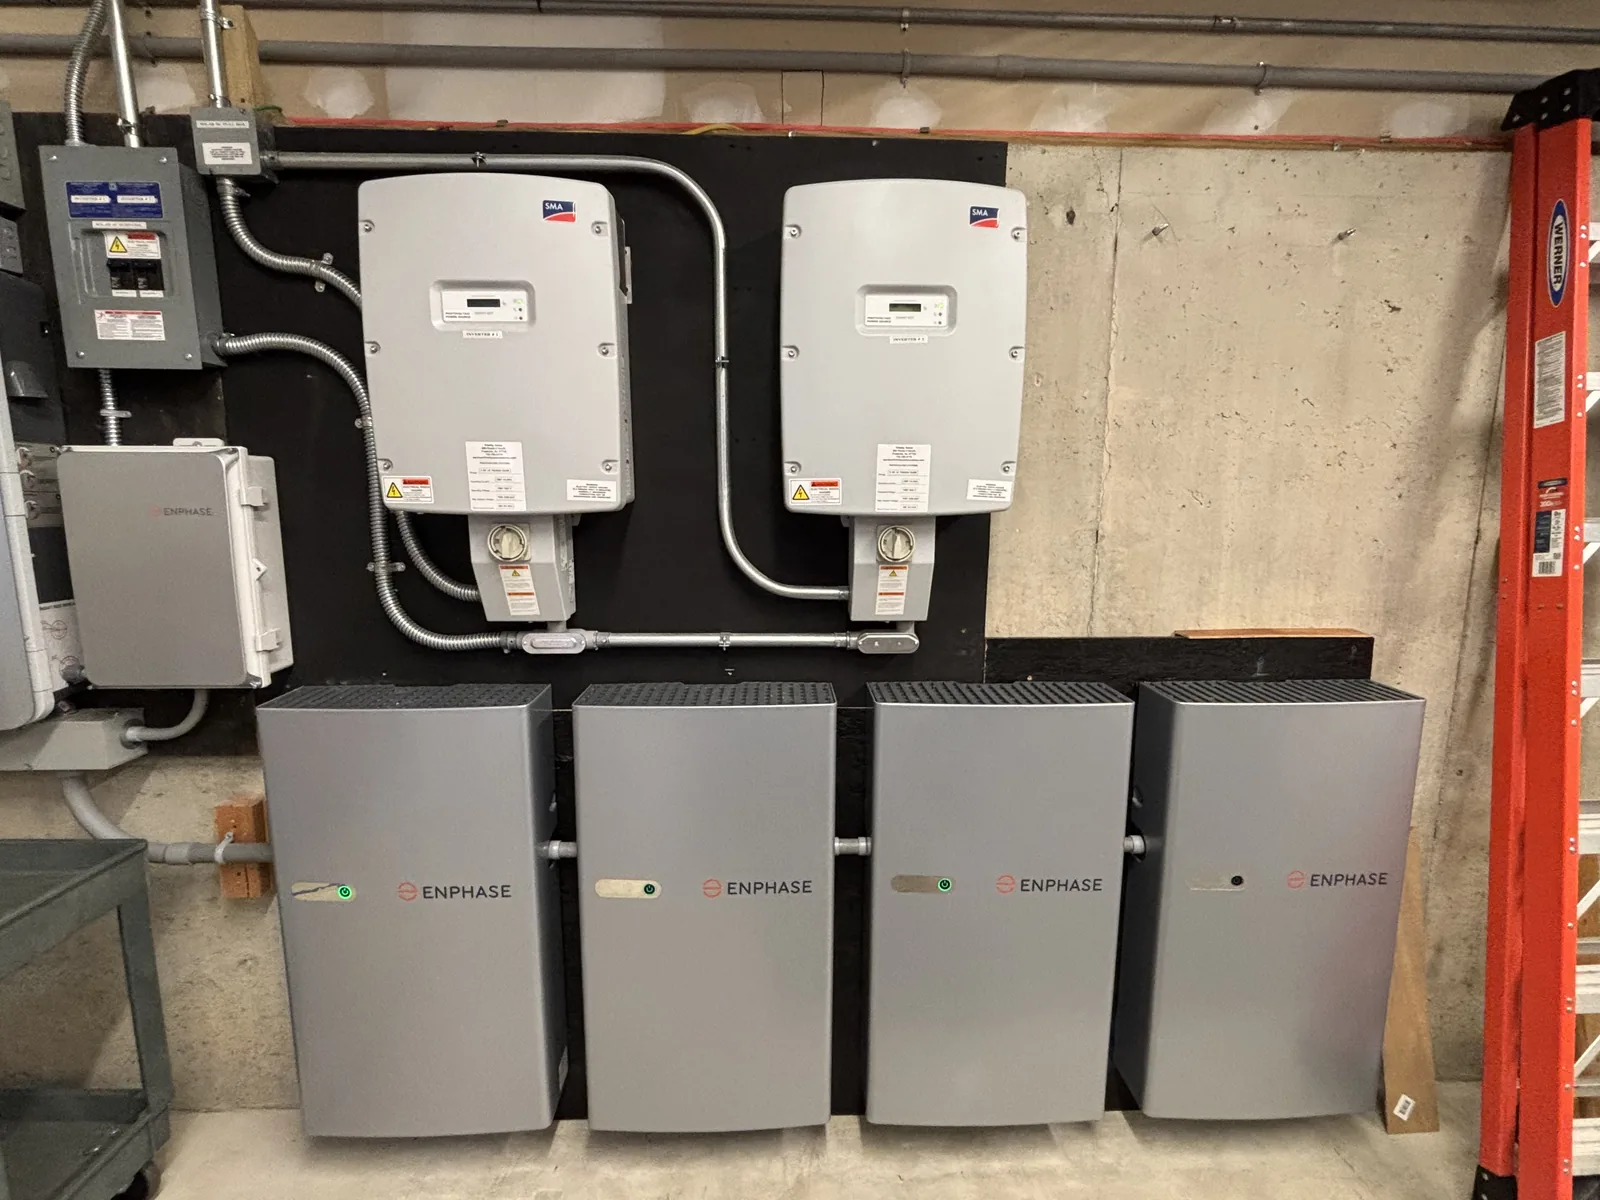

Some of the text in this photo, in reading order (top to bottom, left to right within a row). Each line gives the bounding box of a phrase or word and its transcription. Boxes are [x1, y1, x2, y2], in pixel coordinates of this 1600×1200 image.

[545, 202, 563, 211] SMA
[972, 208, 988, 216] SMA
[1553, 222, 1564, 285] WERNER
[163, 507, 212, 516] ENPHASE
[1020, 878, 1103, 892] ENPHASE
[1309, 872, 1388, 888] ENPHASE
[422, 884, 512, 899] ENPHASE
[727, 880, 812, 895] ENPHASE
